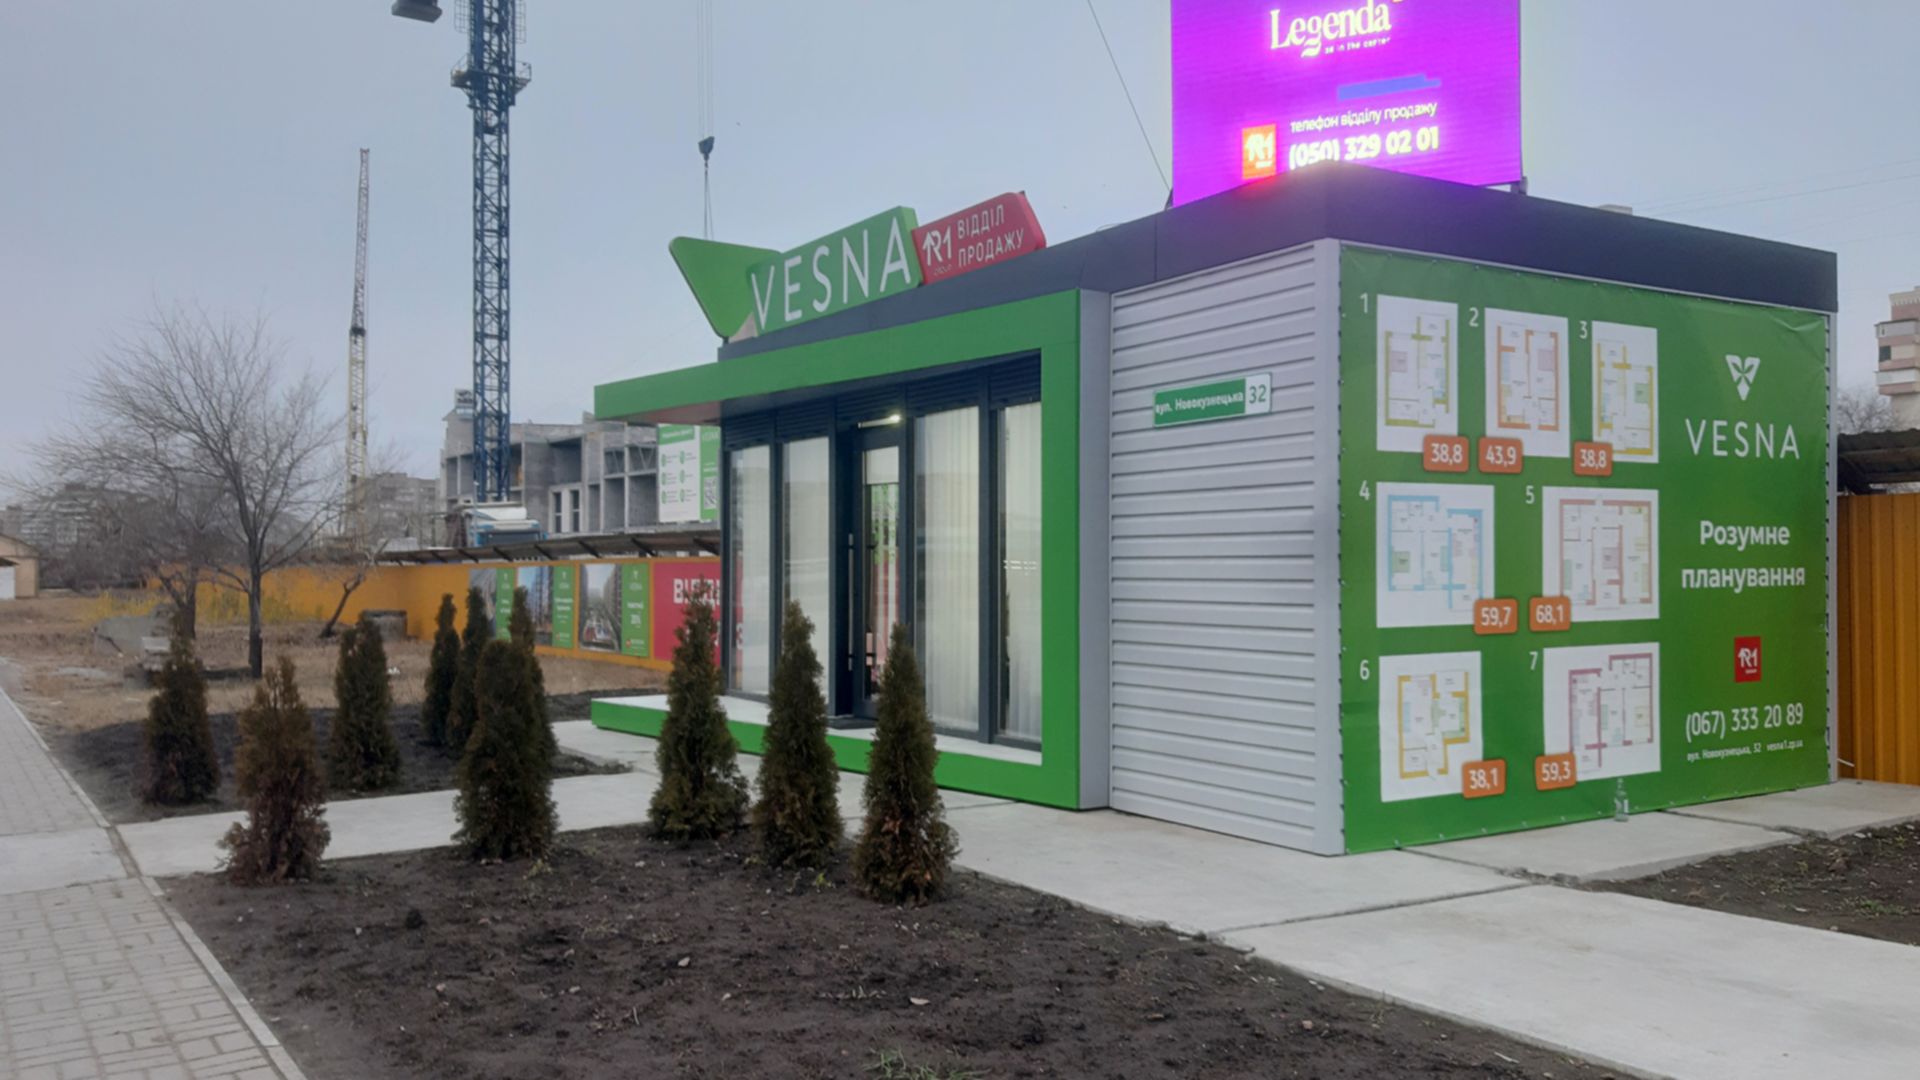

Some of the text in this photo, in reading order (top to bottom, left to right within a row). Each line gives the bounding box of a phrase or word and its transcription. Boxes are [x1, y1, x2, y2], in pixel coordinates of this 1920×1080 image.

[1270, 0, 1392, 58] Legenda
[1290, 102, 1438, 133] телефон відділу продажу
[1289, 126, 1439, 170] (050) 329 02 01
[957, 204, 1005, 239] ВІДДІЛ
[958, 228, 1025, 267] ПРОДАЖУ
[751, 216, 911, 330] VESNA
[1360, 293, 1369, 313] 1
[1469, 307, 1479, 327] 2
[1579, 321, 1588, 339] 3
[1248, 384, 1267, 404] 32
[1684, 418, 1800, 460] VESNA
[1431, 442, 1463, 465] 38,8
[1485, 446, 1517, 467] 43,9
[1579, 449, 1607, 470] 38,8
[1359, 480, 1370, 500] 4
[1525, 485, 1535, 504] 5
[1700, 520, 1790, 552] Розумне
[1681, 566, 1806, 593] планування
[1480, 607, 1511, 628] 59,7
[1535, 605, 1565, 625] 68,1
[1360, 659, 1369, 680] 6
[1529, 652, 1539, 671] 7
[1685, 702, 1804, 743] (067) 333 20 89
[1469, 767, 1499, 790] 38,1
[1541, 760, 1571, 782] 59,3
